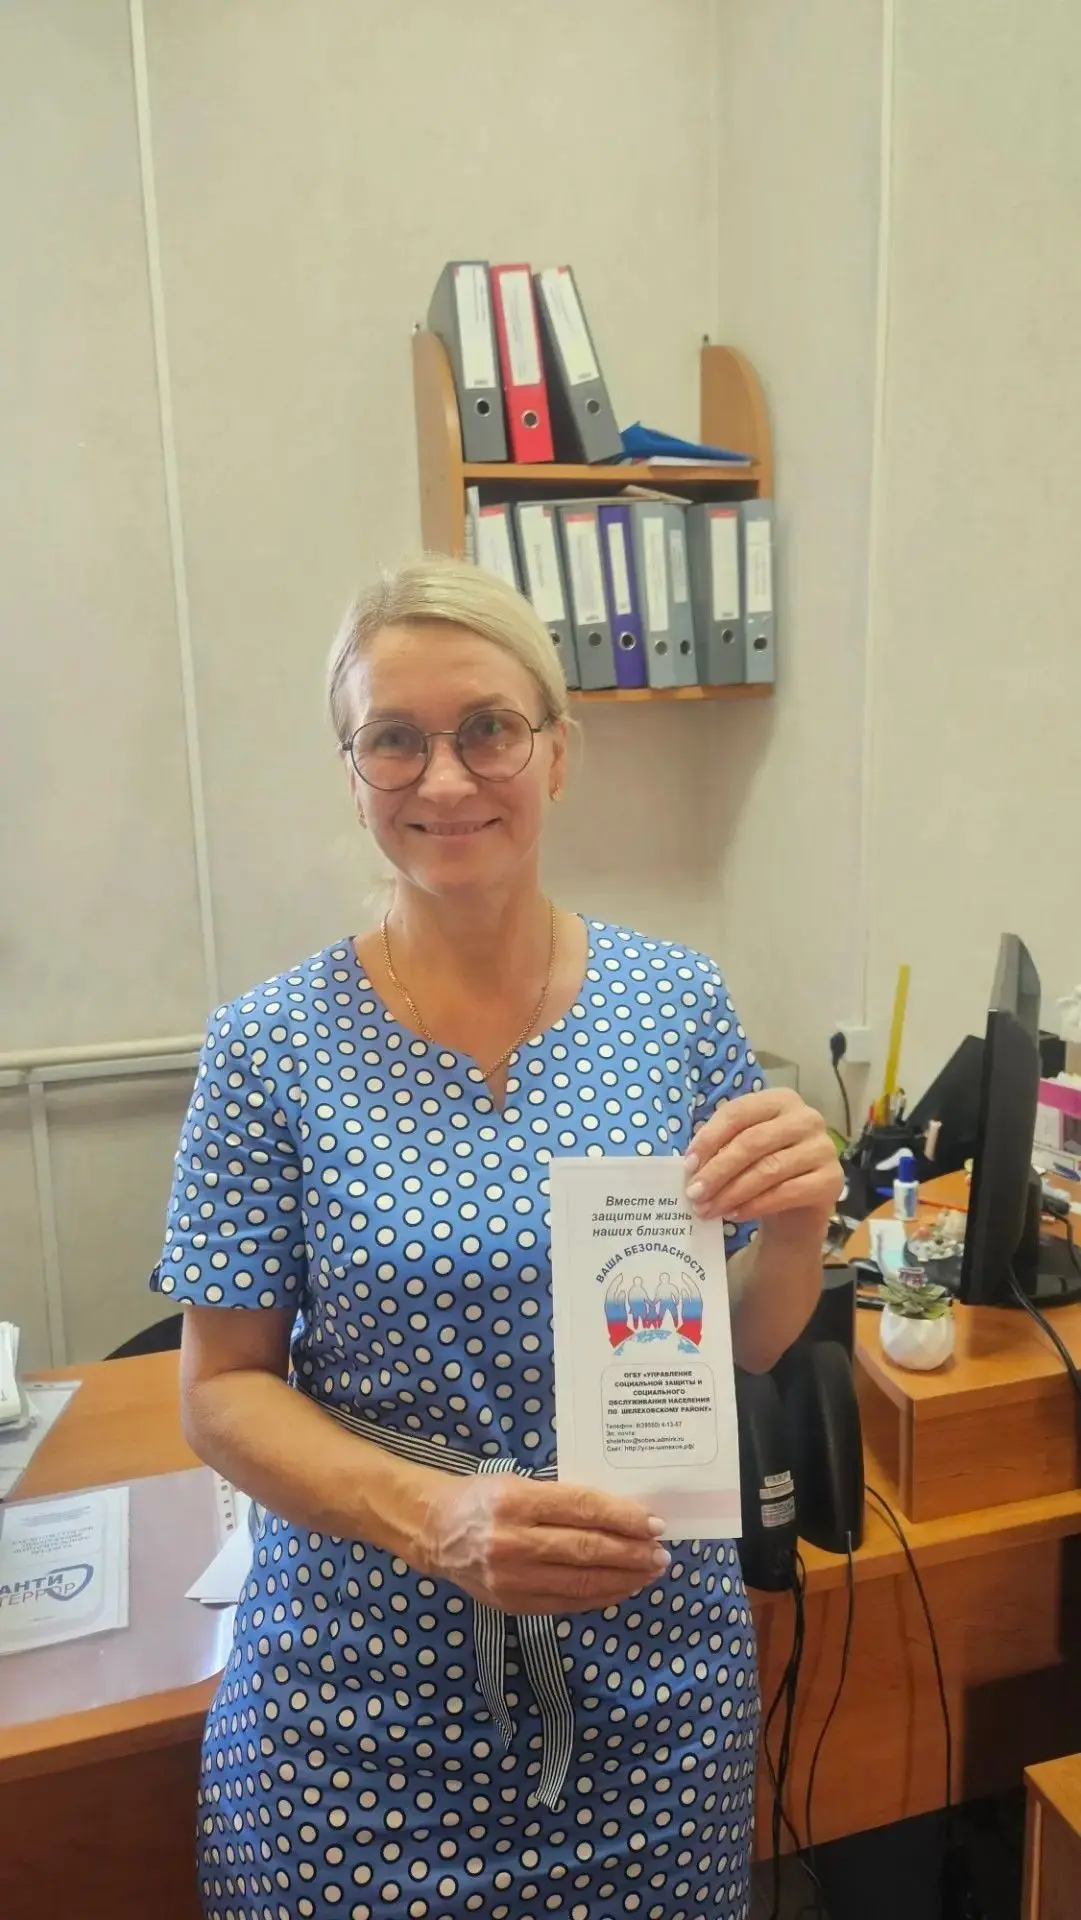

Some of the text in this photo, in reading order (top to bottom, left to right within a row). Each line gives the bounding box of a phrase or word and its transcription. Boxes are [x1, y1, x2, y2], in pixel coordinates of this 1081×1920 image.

[605, 1195, 678, 1206] Вместе мы
[591, 1212, 692, 1224] защитим жизнь
[592, 1227, 633, 1237] наших
[636, 1226, 686, 1237] близких
[596, 1242, 707, 1284] ВАША БЕЗОПАСНОСТЬ
[621, 1407, 679, 1415] ШЕЛЕХОВСКОМУ
[0, 1573, 64, 1595] АНТИ
